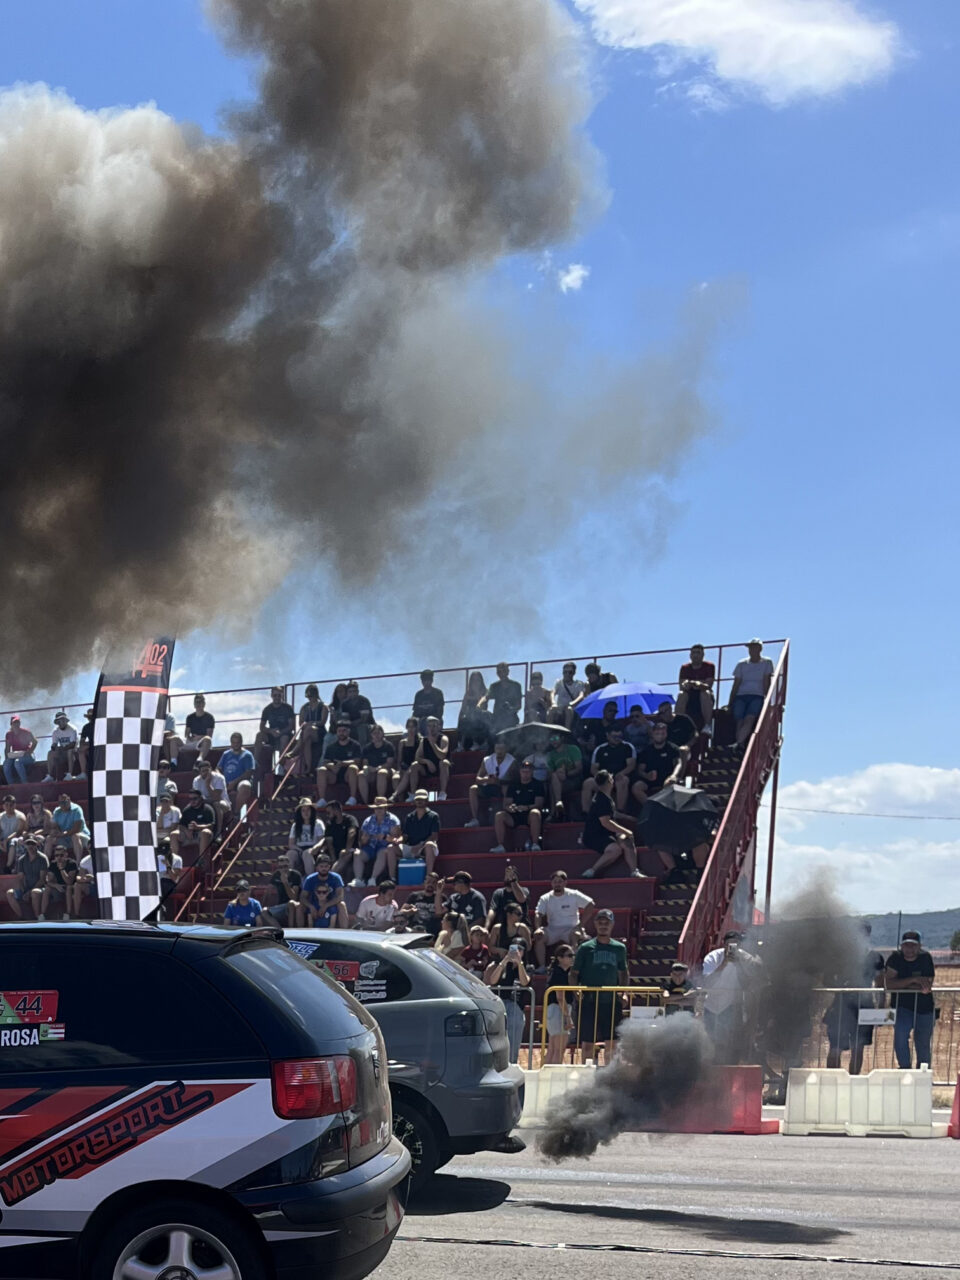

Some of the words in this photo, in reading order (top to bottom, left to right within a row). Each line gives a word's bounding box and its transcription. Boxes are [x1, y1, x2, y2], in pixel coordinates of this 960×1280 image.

[333, 964, 349, 976] 56
[14, 995, 43, 1016] 44
[0, 1028, 40, 1047] ROSA
